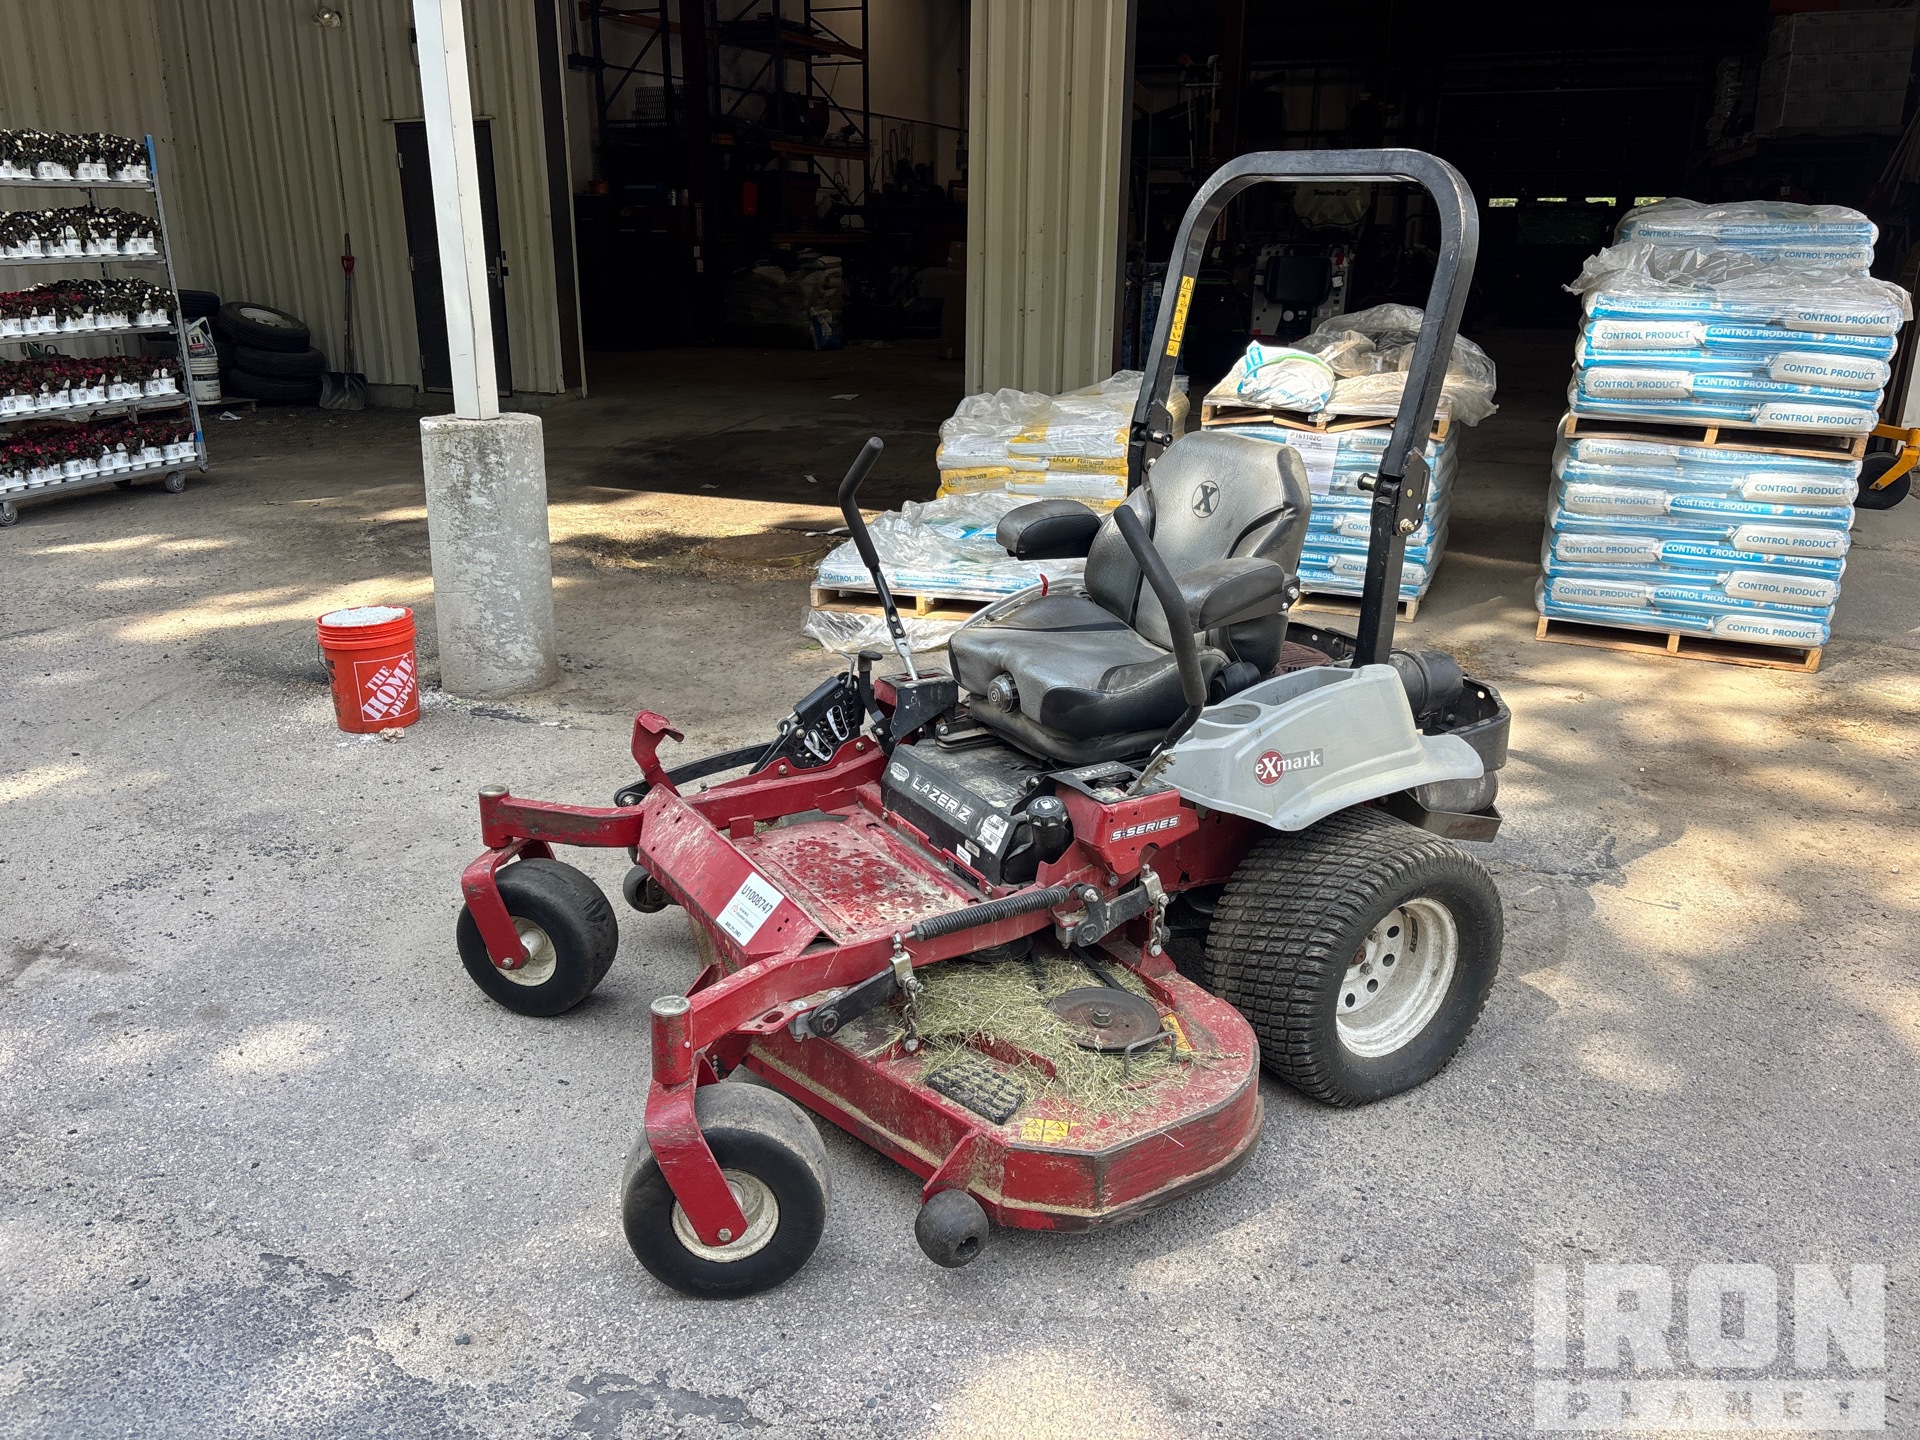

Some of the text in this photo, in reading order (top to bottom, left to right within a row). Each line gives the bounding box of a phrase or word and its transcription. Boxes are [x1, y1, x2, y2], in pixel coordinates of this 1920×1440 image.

[1638, 229, 1672, 238] CONTROL
[1784, 251, 1864, 260] CONTROL PRODUCT
[1798, 311, 1891, 325] CONTROL PRODUCT
[1601, 330, 1691, 340] CONTROL PRODUCT
[1709, 327, 1803, 339] CONTROL PRODUCT
[1834, 334, 1877, 344] NUTRITE
[1783, 363, 1876, 380] CONTROL PRODUCT
[1594, 380, 1681, 389] CONTROL PRODUCT
[1697, 378, 1790, 390] CONTROL PRODUCT
[1769, 412, 1864, 425] CONTROL PRODUCT
[1356, 437, 1388, 446] CONTRO
[1755, 483, 1847, 496] CONTROL PRODUCT
[1573, 495, 1657, 505] CONTROL PRODUCT
[1675, 497, 1763, 513] CONTROL PRODUCT
[1793, 507, 1833, 517] NUTRITE
[1348, 522, 1371, 532] CONT
[1746, 535, 1838, 549] CONTROL PRODUCT
[1565, 546, 1649, 555] CONTROL PRODUCT
[1665, 544, 1755, 560] CONTROL PRODUCT
[1784, 556, 1824, 567] NUTRITE
[854, 574, 871, 582] PRO
[1558, 586, 1642, 598] CONTROL PRODUCT
[1737, 581, 1827, 598] CONTROL PRODUCT
[1657, 589, 1745, 605] CONTROL PRODUCT
[1727, 623, 1817, 639] CONTROL PRODUCT
[365, 665, 393, 691] THE
[361, 654, 413, 720] HOME
[1255, 750, 1321, 780] eXmark
[911, 774, 974, 823] LAZER Z
[741, 884, 774, 914] U1008747
